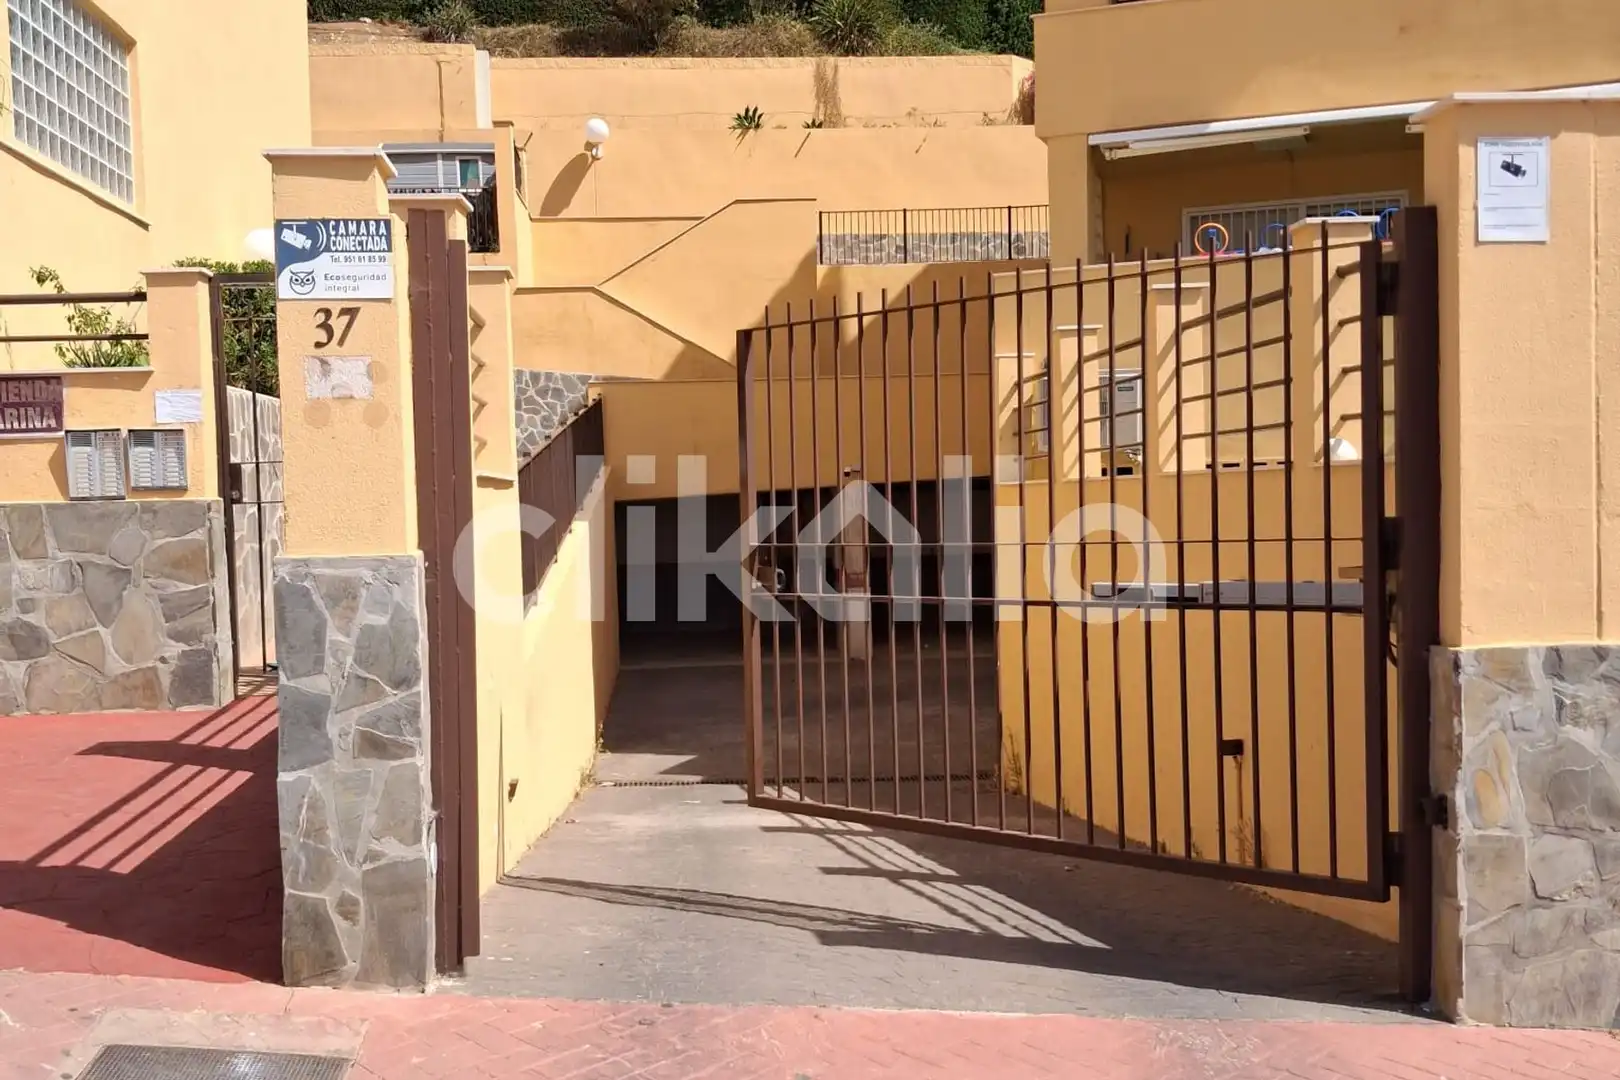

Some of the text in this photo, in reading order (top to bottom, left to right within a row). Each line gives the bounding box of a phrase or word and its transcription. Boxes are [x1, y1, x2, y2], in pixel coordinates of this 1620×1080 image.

[329, 220, 387, 235] CAMARA
[330, 236, 388, 251] CONECTADA
[324, 273, 387, 282] Ecoseguridad
[324, 285, 359, 293] integral
[313, 306, 361, 349] 37
